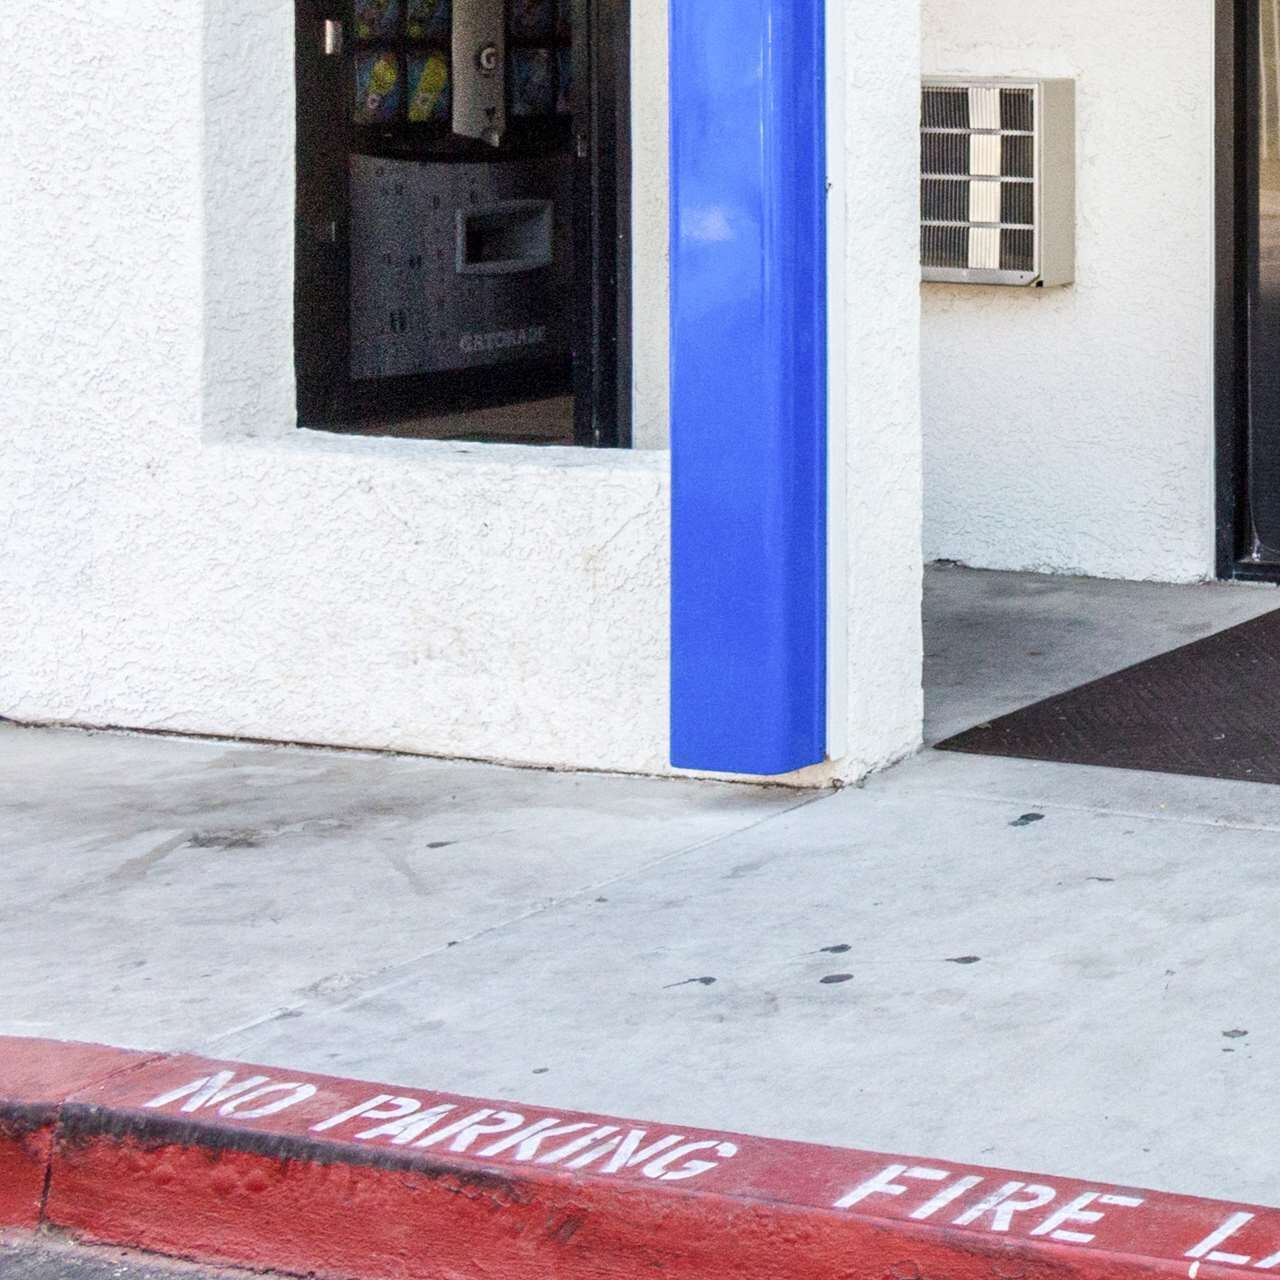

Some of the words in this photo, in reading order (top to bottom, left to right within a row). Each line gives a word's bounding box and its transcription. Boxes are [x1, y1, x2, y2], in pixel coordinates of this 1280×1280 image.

[144, 1070, 316, 1120] NO
[311, 1094, 738, 1181] PARKING
[833, 1164, 1145, 1244] FIRE
